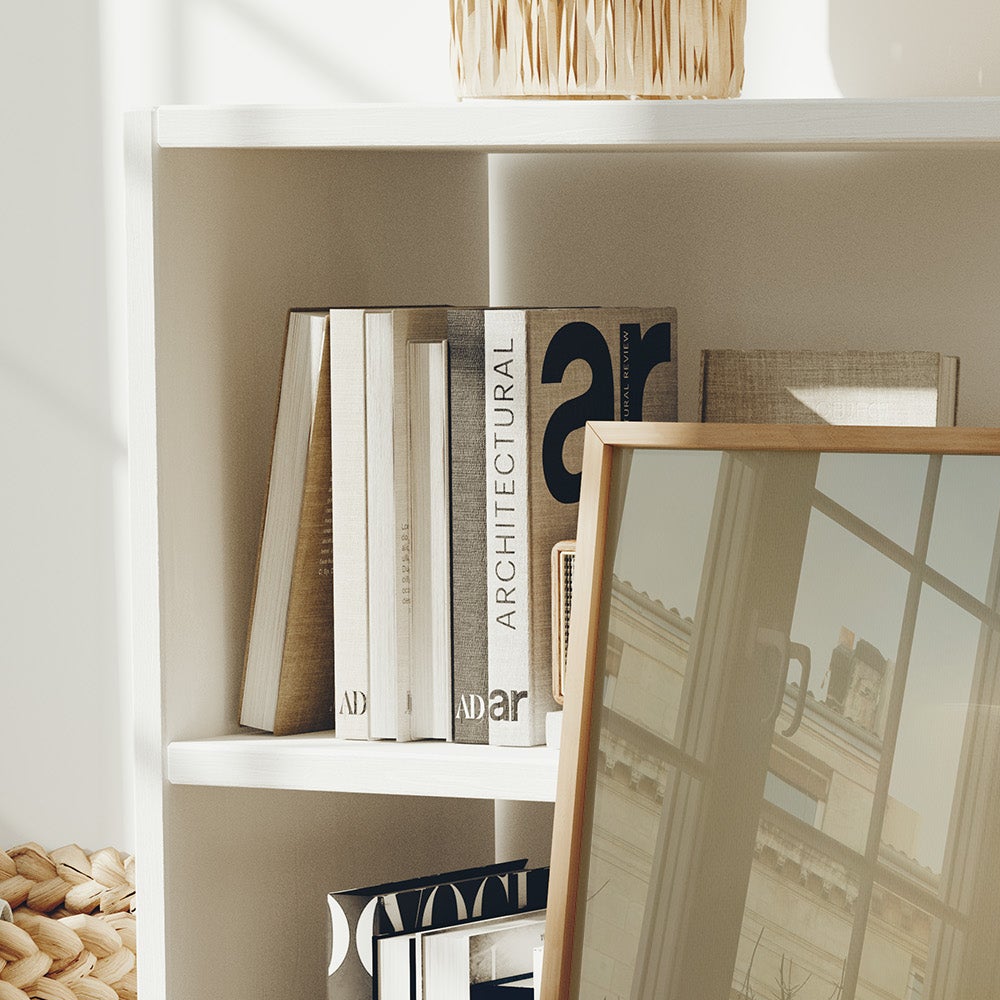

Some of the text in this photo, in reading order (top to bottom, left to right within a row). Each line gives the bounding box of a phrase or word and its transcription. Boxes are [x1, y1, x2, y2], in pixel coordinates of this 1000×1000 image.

[541, 321, 671, 504] ar
[493, 338, 517, 630] ARCHITECTURAL
[339, 690, 367, 715] AD
[455, 694, 485, 720] AD
[489, 689, 528, 722] ar
